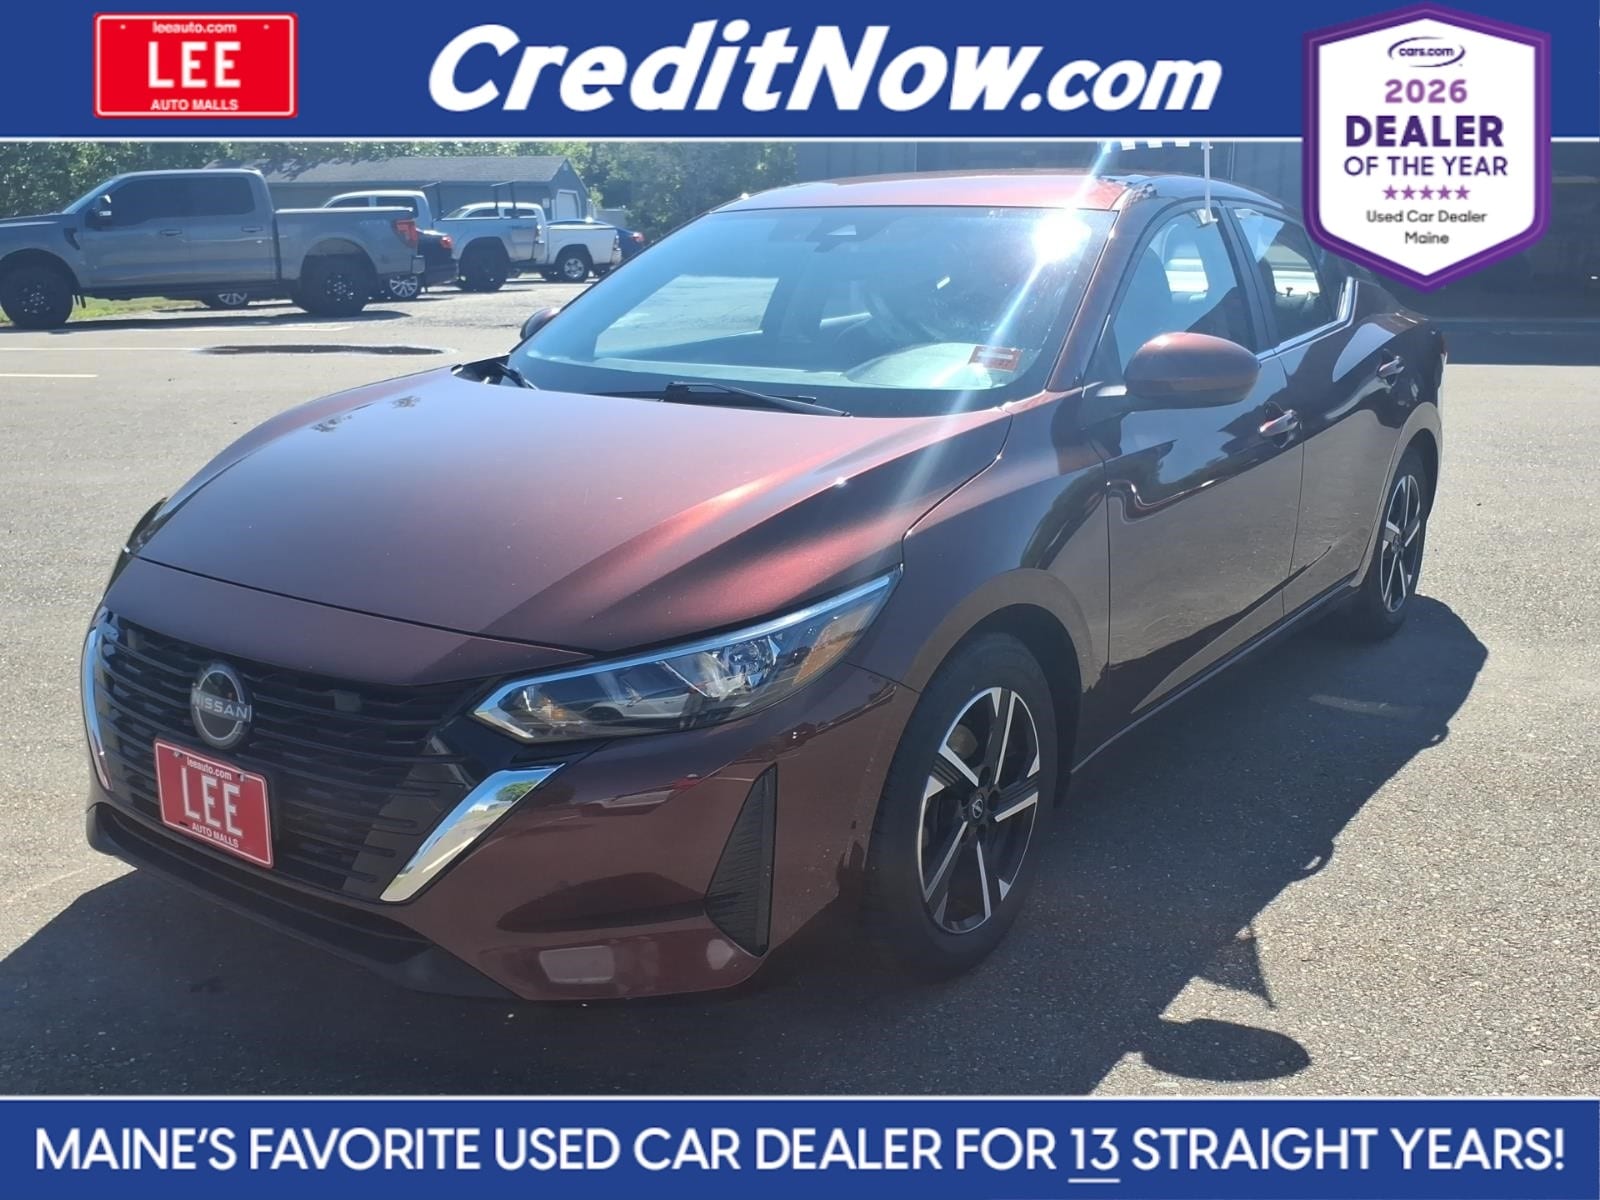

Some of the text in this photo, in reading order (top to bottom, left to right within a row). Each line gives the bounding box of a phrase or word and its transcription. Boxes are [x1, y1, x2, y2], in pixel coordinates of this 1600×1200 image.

[191, 687, 248, 719] NISSAN
[181, 766, 243, 837] LEE
[192, 822, 239, 848] AUTO MALLS
